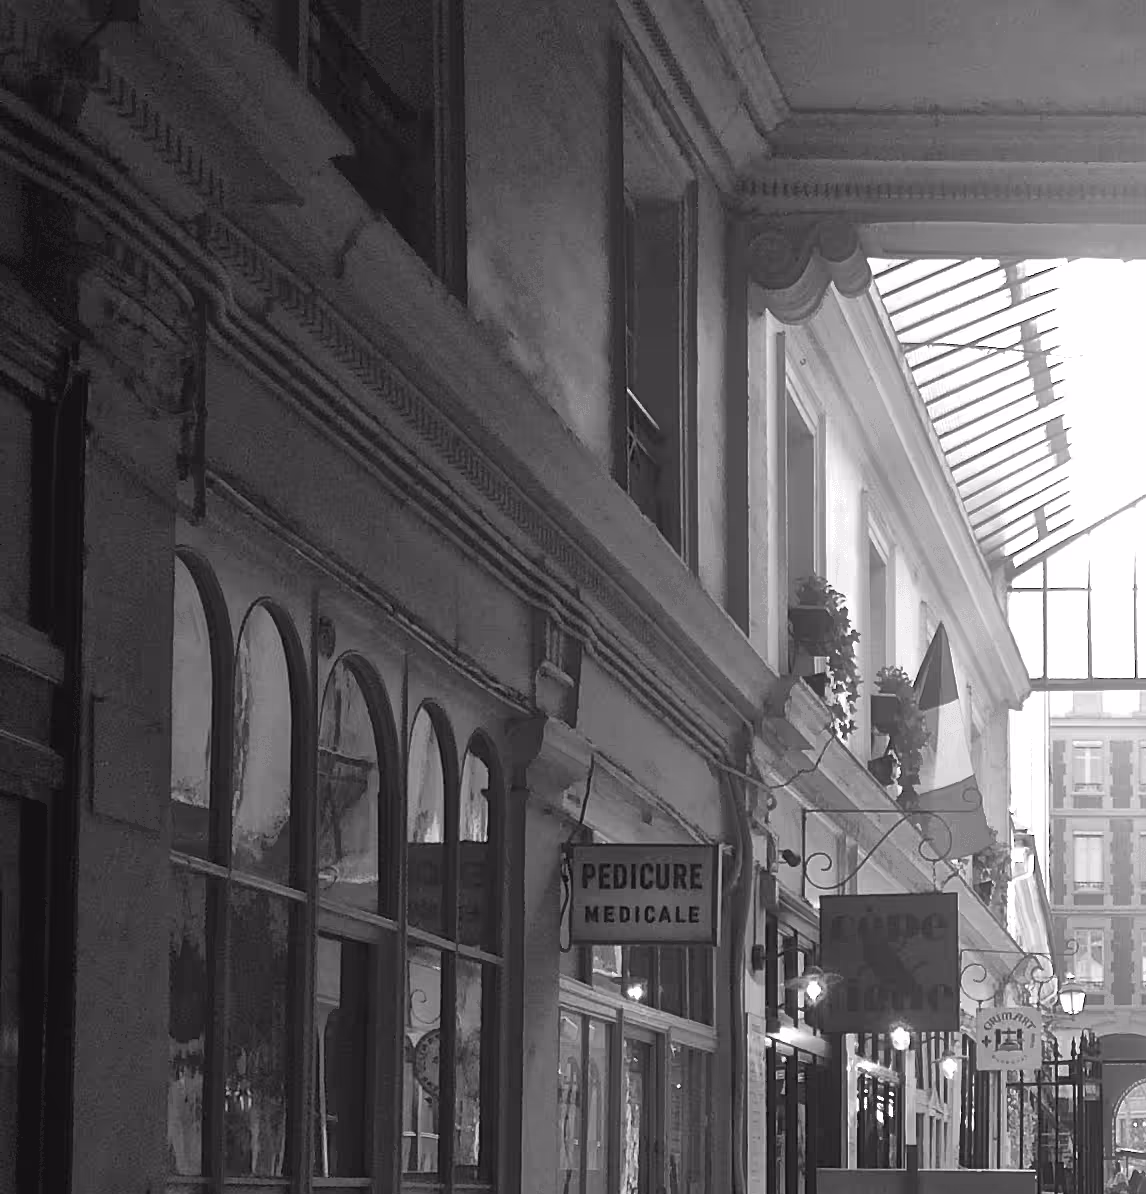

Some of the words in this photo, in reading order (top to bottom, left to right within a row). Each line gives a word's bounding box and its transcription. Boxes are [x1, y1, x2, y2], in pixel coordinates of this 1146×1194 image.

[582, 863, 703, 890] PEDICURE
[584, 905, 700, 924] MEDICALE
[983, 1011, 1037, 1031] ORIMART
